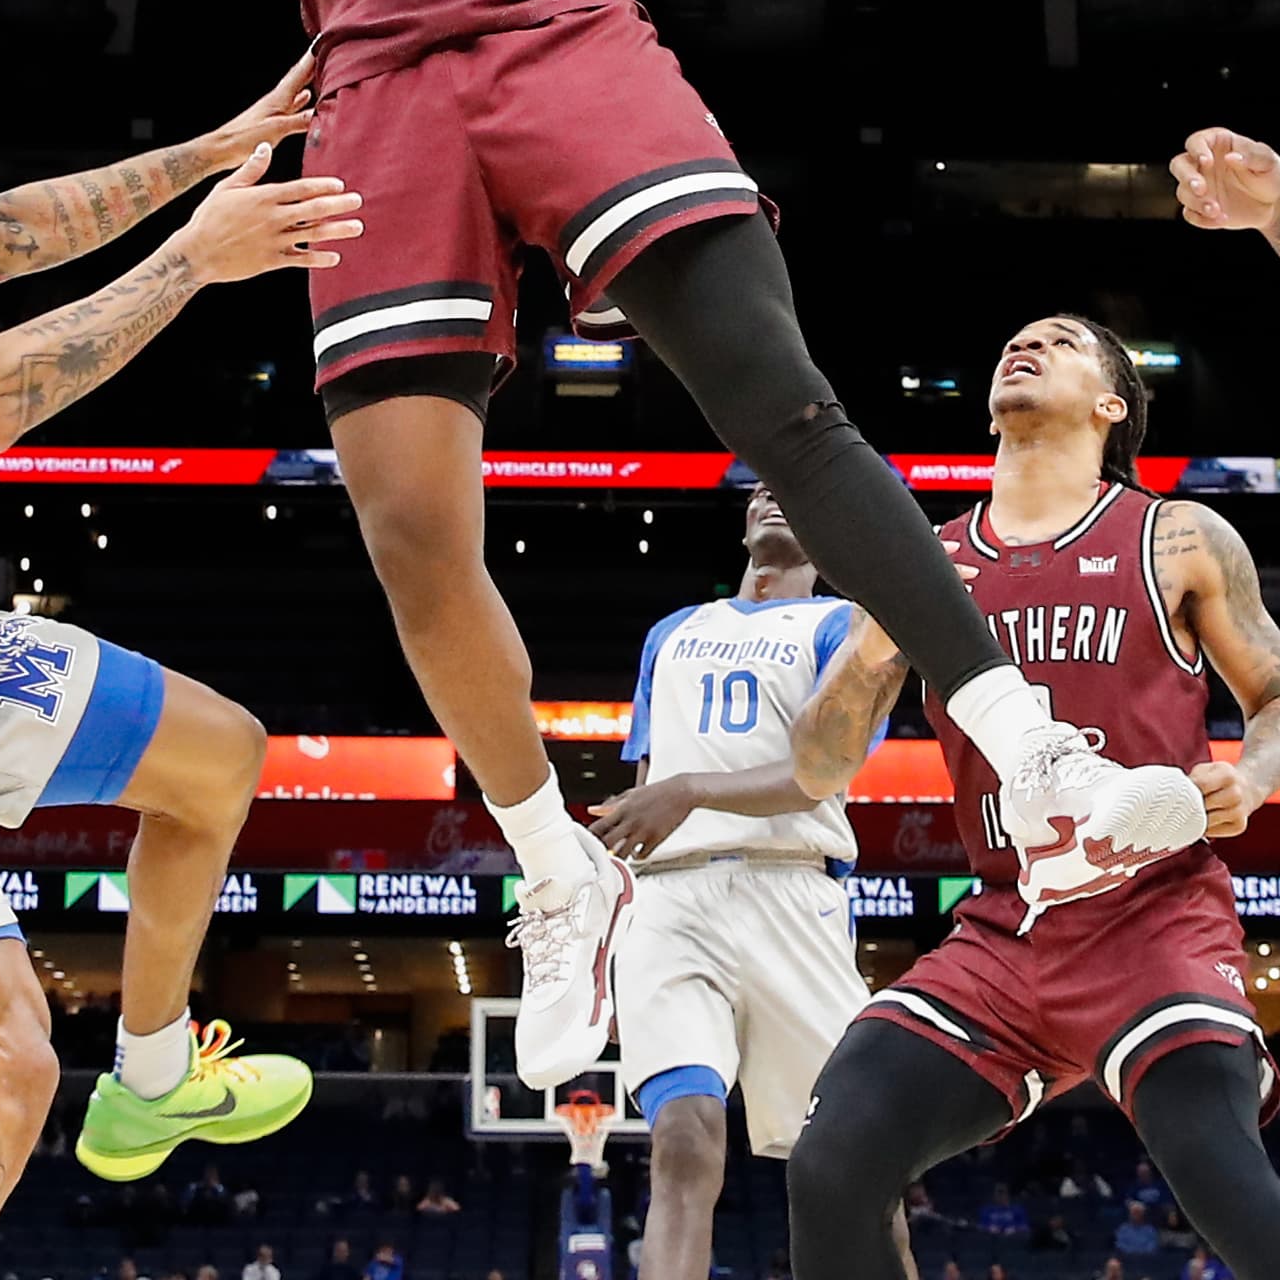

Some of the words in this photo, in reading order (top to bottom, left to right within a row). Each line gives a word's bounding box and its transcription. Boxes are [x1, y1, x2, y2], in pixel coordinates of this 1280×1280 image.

[33, 458, 107, 473] VEHICLES
[109, 458, 154, 473] THAN
[494, 462, 565, 477] VEHICLES
[568, 462, 613, 477] THAN
[910, 465, 949, 480] AWD
[988, 605, 1128, 665] THERN
[671, 635, 800, 666] Memphis
[697, 668, 759, 735] 10
[358, 874, 477, 897] RENEWAL
[846, 877, 913, 898] EWAL
[375, 897, 477, 915] ANDERSEN
[852, 898, 914, 917] ERSEN
